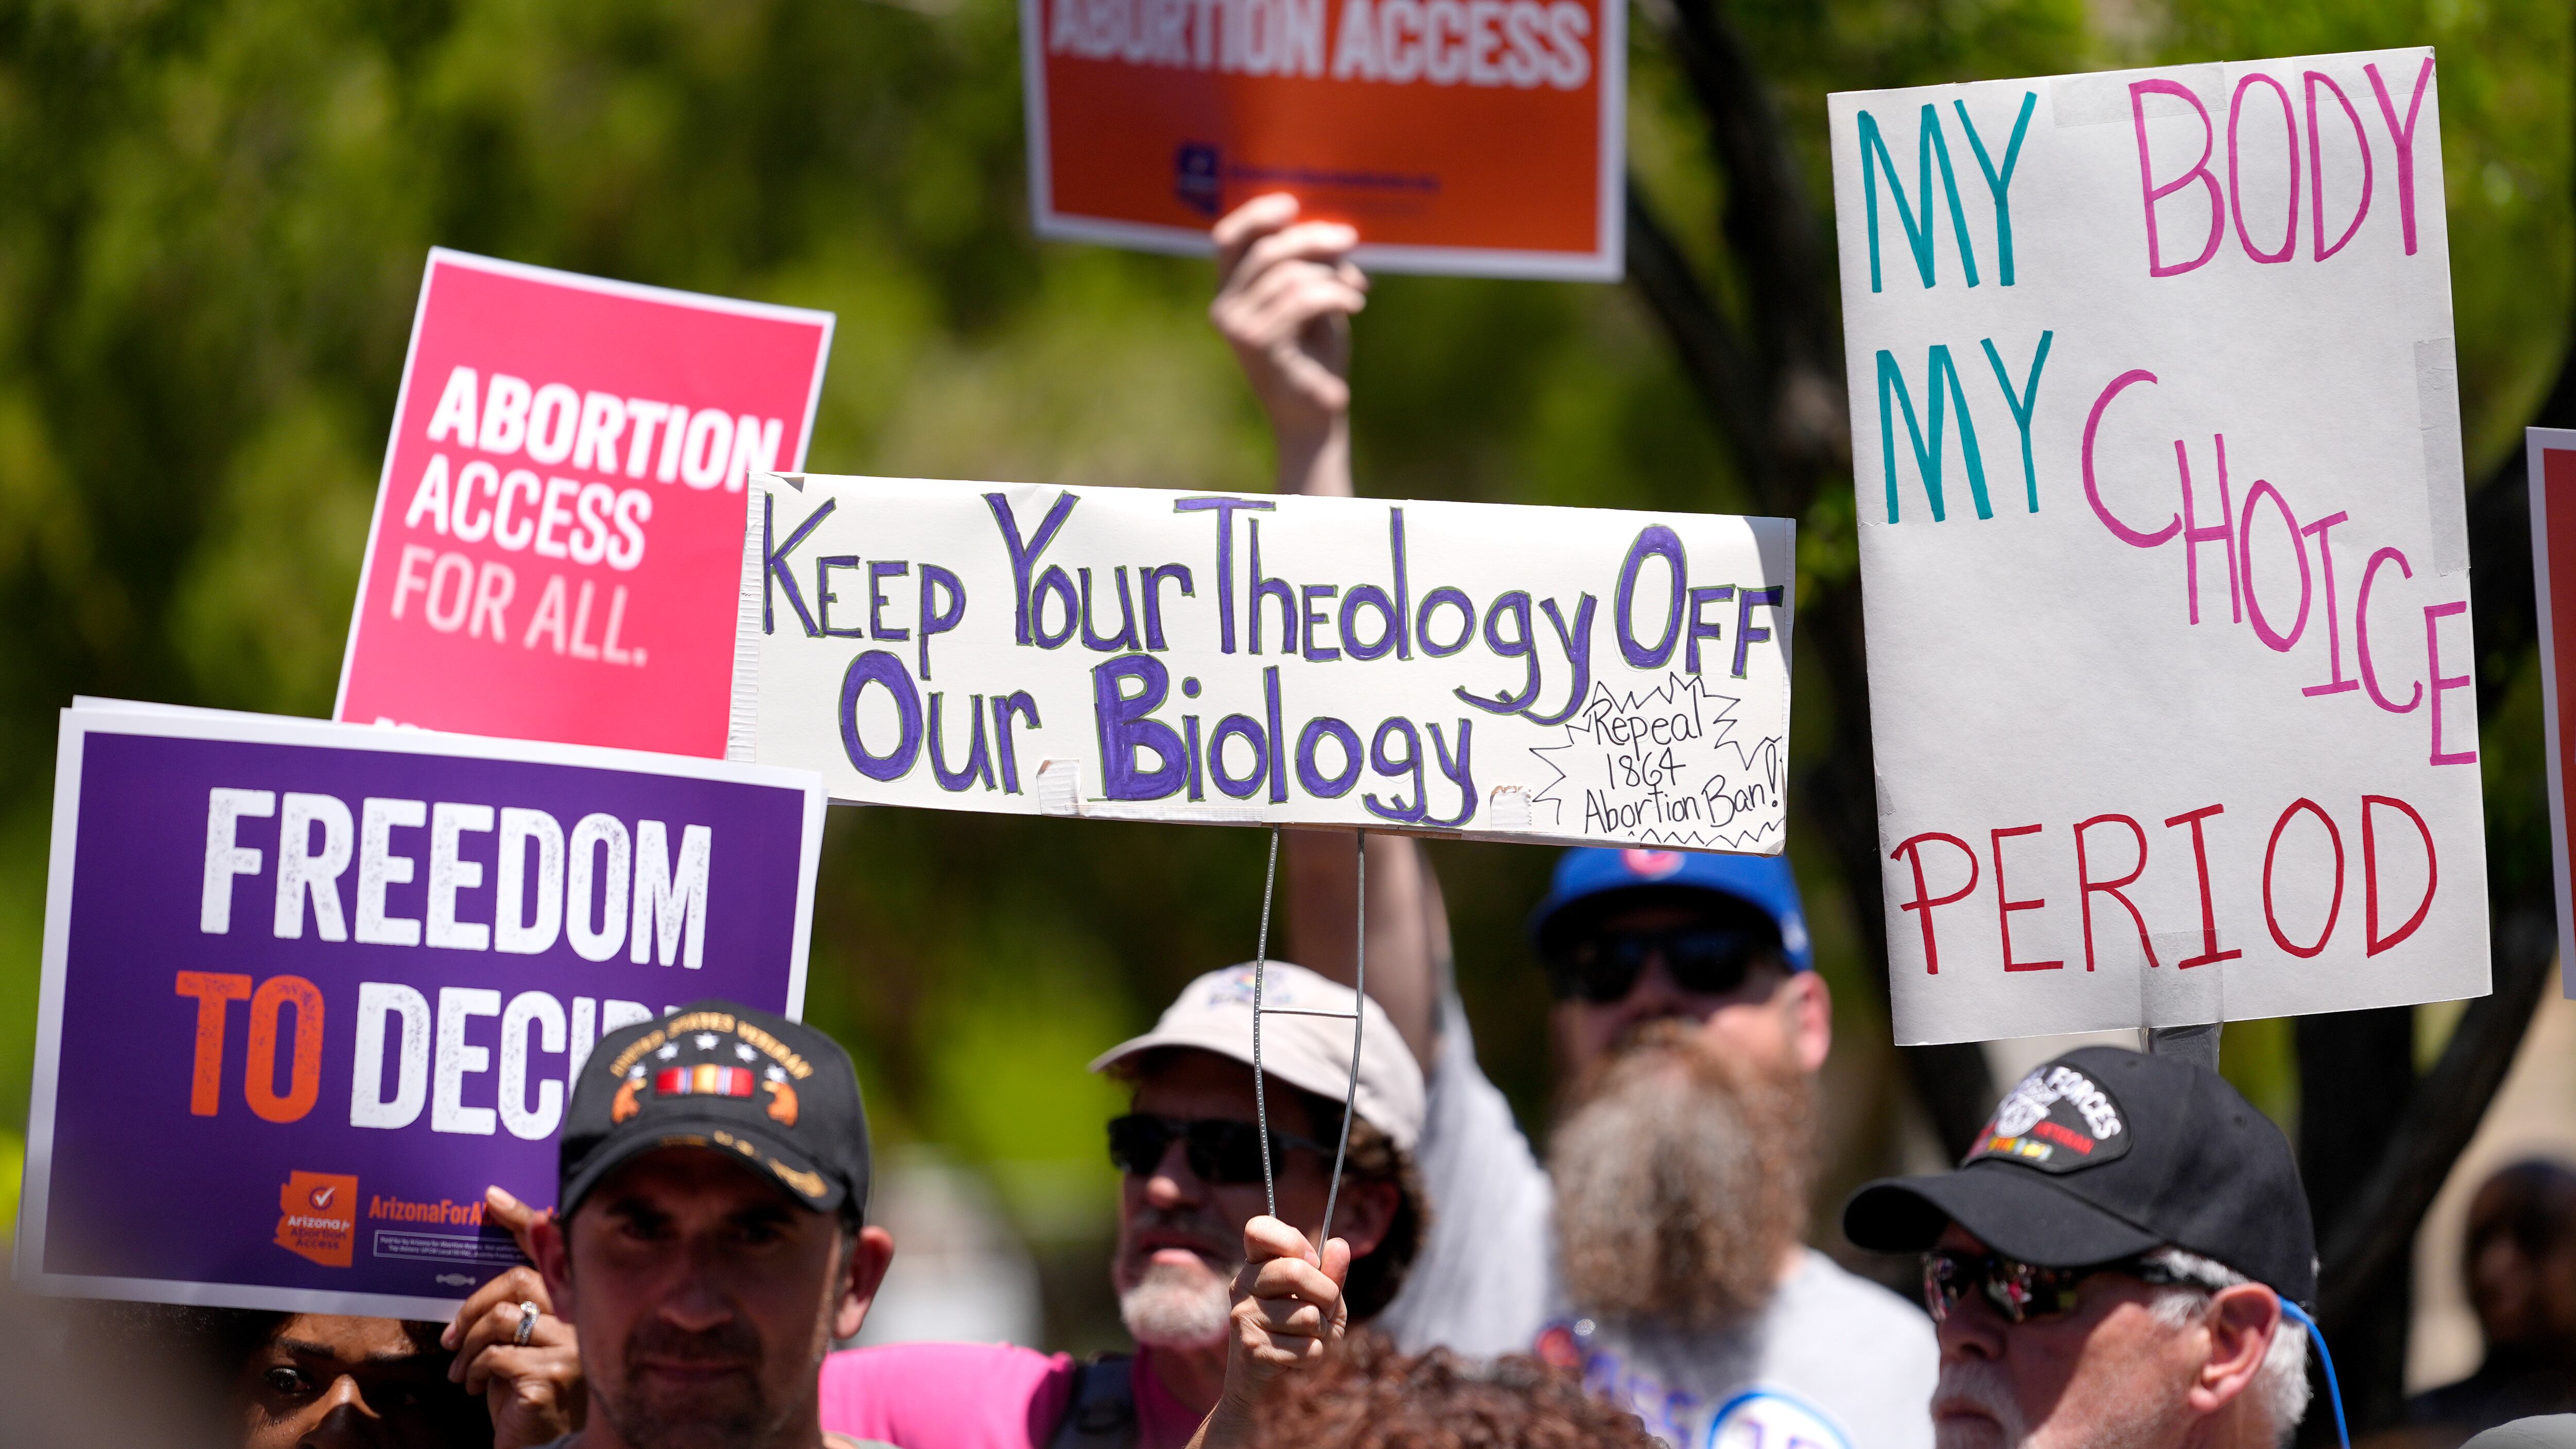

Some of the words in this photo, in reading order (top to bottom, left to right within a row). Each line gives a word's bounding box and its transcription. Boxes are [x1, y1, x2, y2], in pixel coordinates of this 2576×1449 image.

[1048, 0, 1326, 78] ABORTION
[1331, 0, 1591, 91] ACCESS
[1857, 92, 2037, 293] MY
[2129, 57, 2435, 278] BODY
[427, 366, 784, 493] ABORTION
[405, 453, 653, 570] ACCESS
[1876, 330, 2053, 525] MY
[2082, 369, 2477, 766] CHOICE
[391, 544, 517, 644] FOR
[523, 573, 648, 669] ALL.
[981, 490, 1195, 651] Your
[1614, 524, 1784, 679] OFF
[839, 650, 1041, 795] Our
[1088, 652, 1479, 827] Biology
[1583, 684, 1703, 762] Repeal
[1607, 747, 1687, 790] 1864
[1585, 784, 1701, 834] Abortion
[1701, 743, 1777, 828] Ban!
[199, 786, 712, 970] FREEDOM
[1890, 795, 2437, 975] PERIOD
[176, 971, 325, 1123] TO
[349, 982, 683, 1141] DECI
[2044, 1066, 2122, 1140] FORCES
[287, 1215, 341, 1230] Arizona
